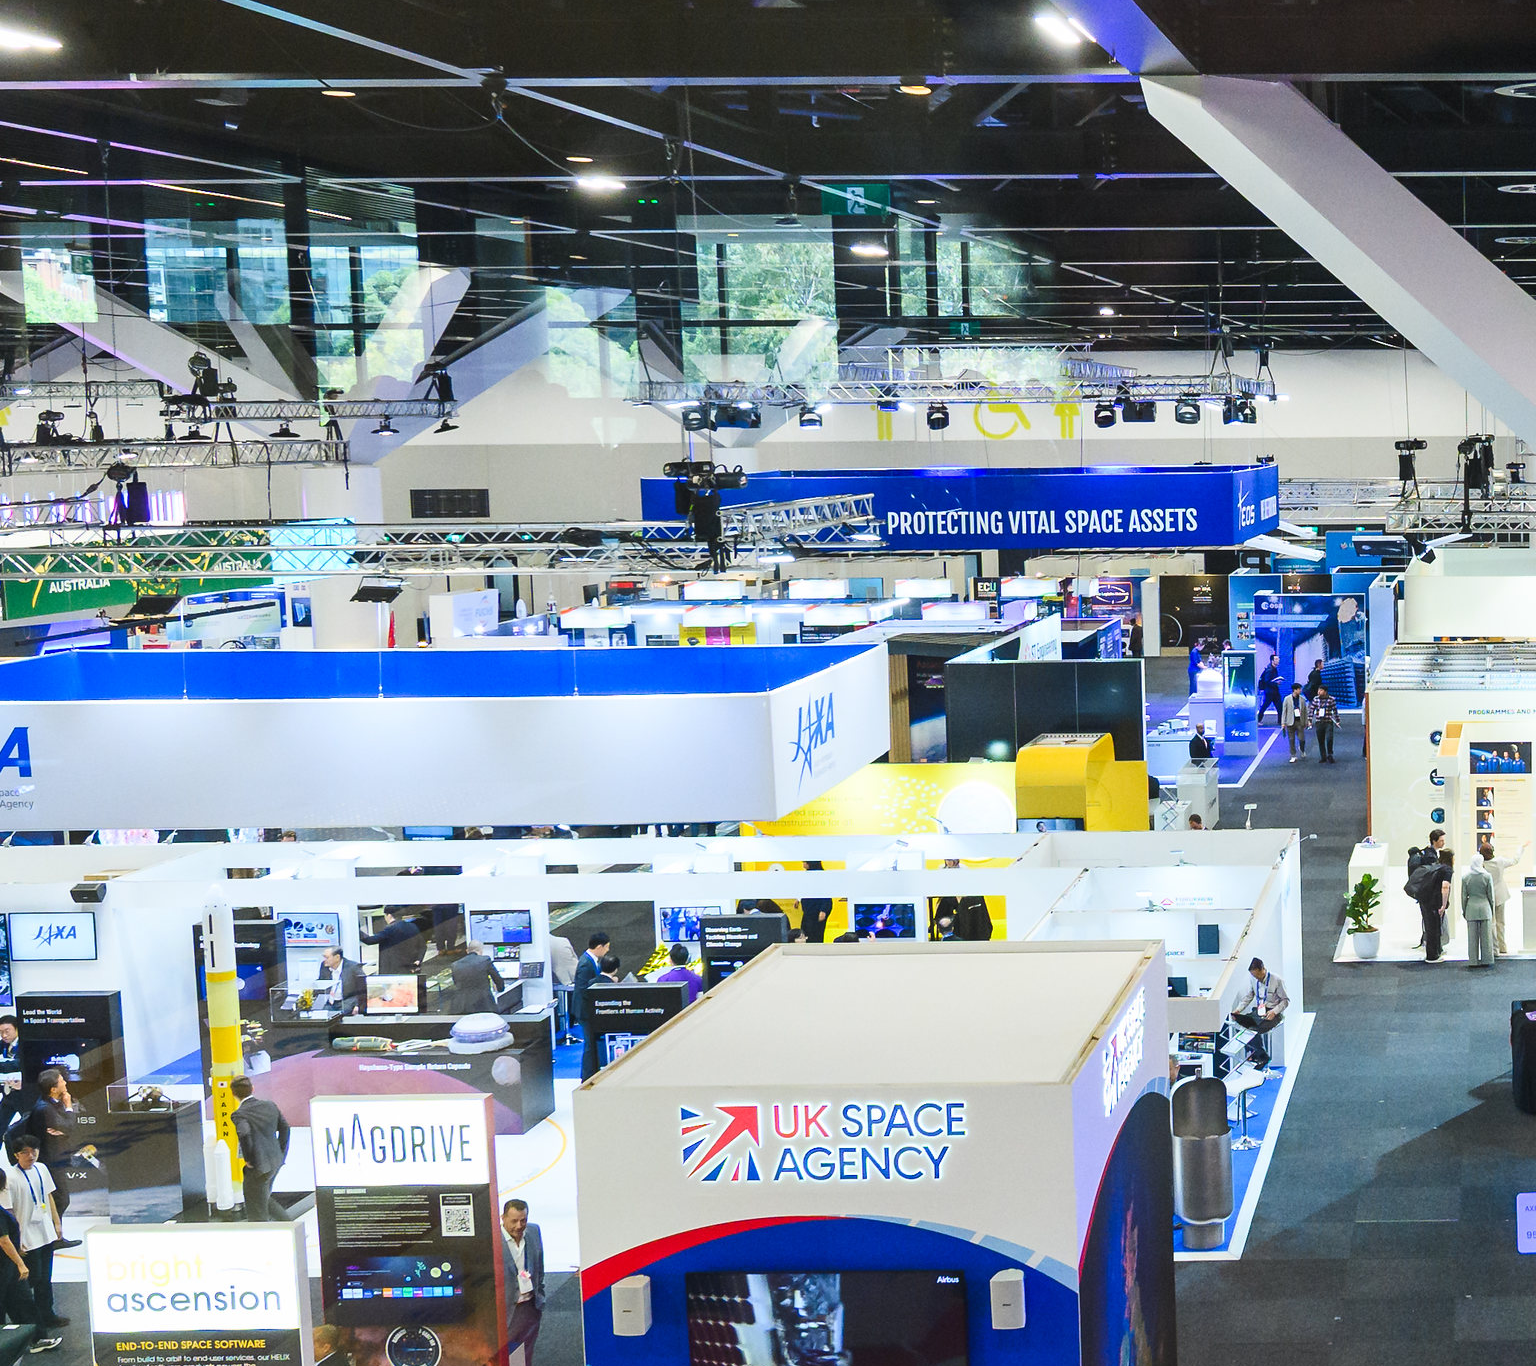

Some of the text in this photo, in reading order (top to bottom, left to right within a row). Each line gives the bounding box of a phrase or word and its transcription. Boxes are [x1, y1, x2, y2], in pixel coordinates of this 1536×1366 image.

[887, 508, 1198, 535] PROTECTING VITAL SPACE ASSETS
[49, 578, 111, 594] AUSTRALIA
[978, 582, 996, 591] ECU
[789, 692, 835, 797] JAXA
[0, 800, 34, 811] Agency
[774, 1103, 966, 1138] UK SPACE
[325, 1113, 472, 1164] MAGDRIVE
[774, 1146, 950, 1181] AGENCY
[937, 1275, 959, 1284] Airbus
[107, 1285, 281, 1312] ascension
[116, 1339, 265, 1351] END-TO-END SPACE SOFTWARE
